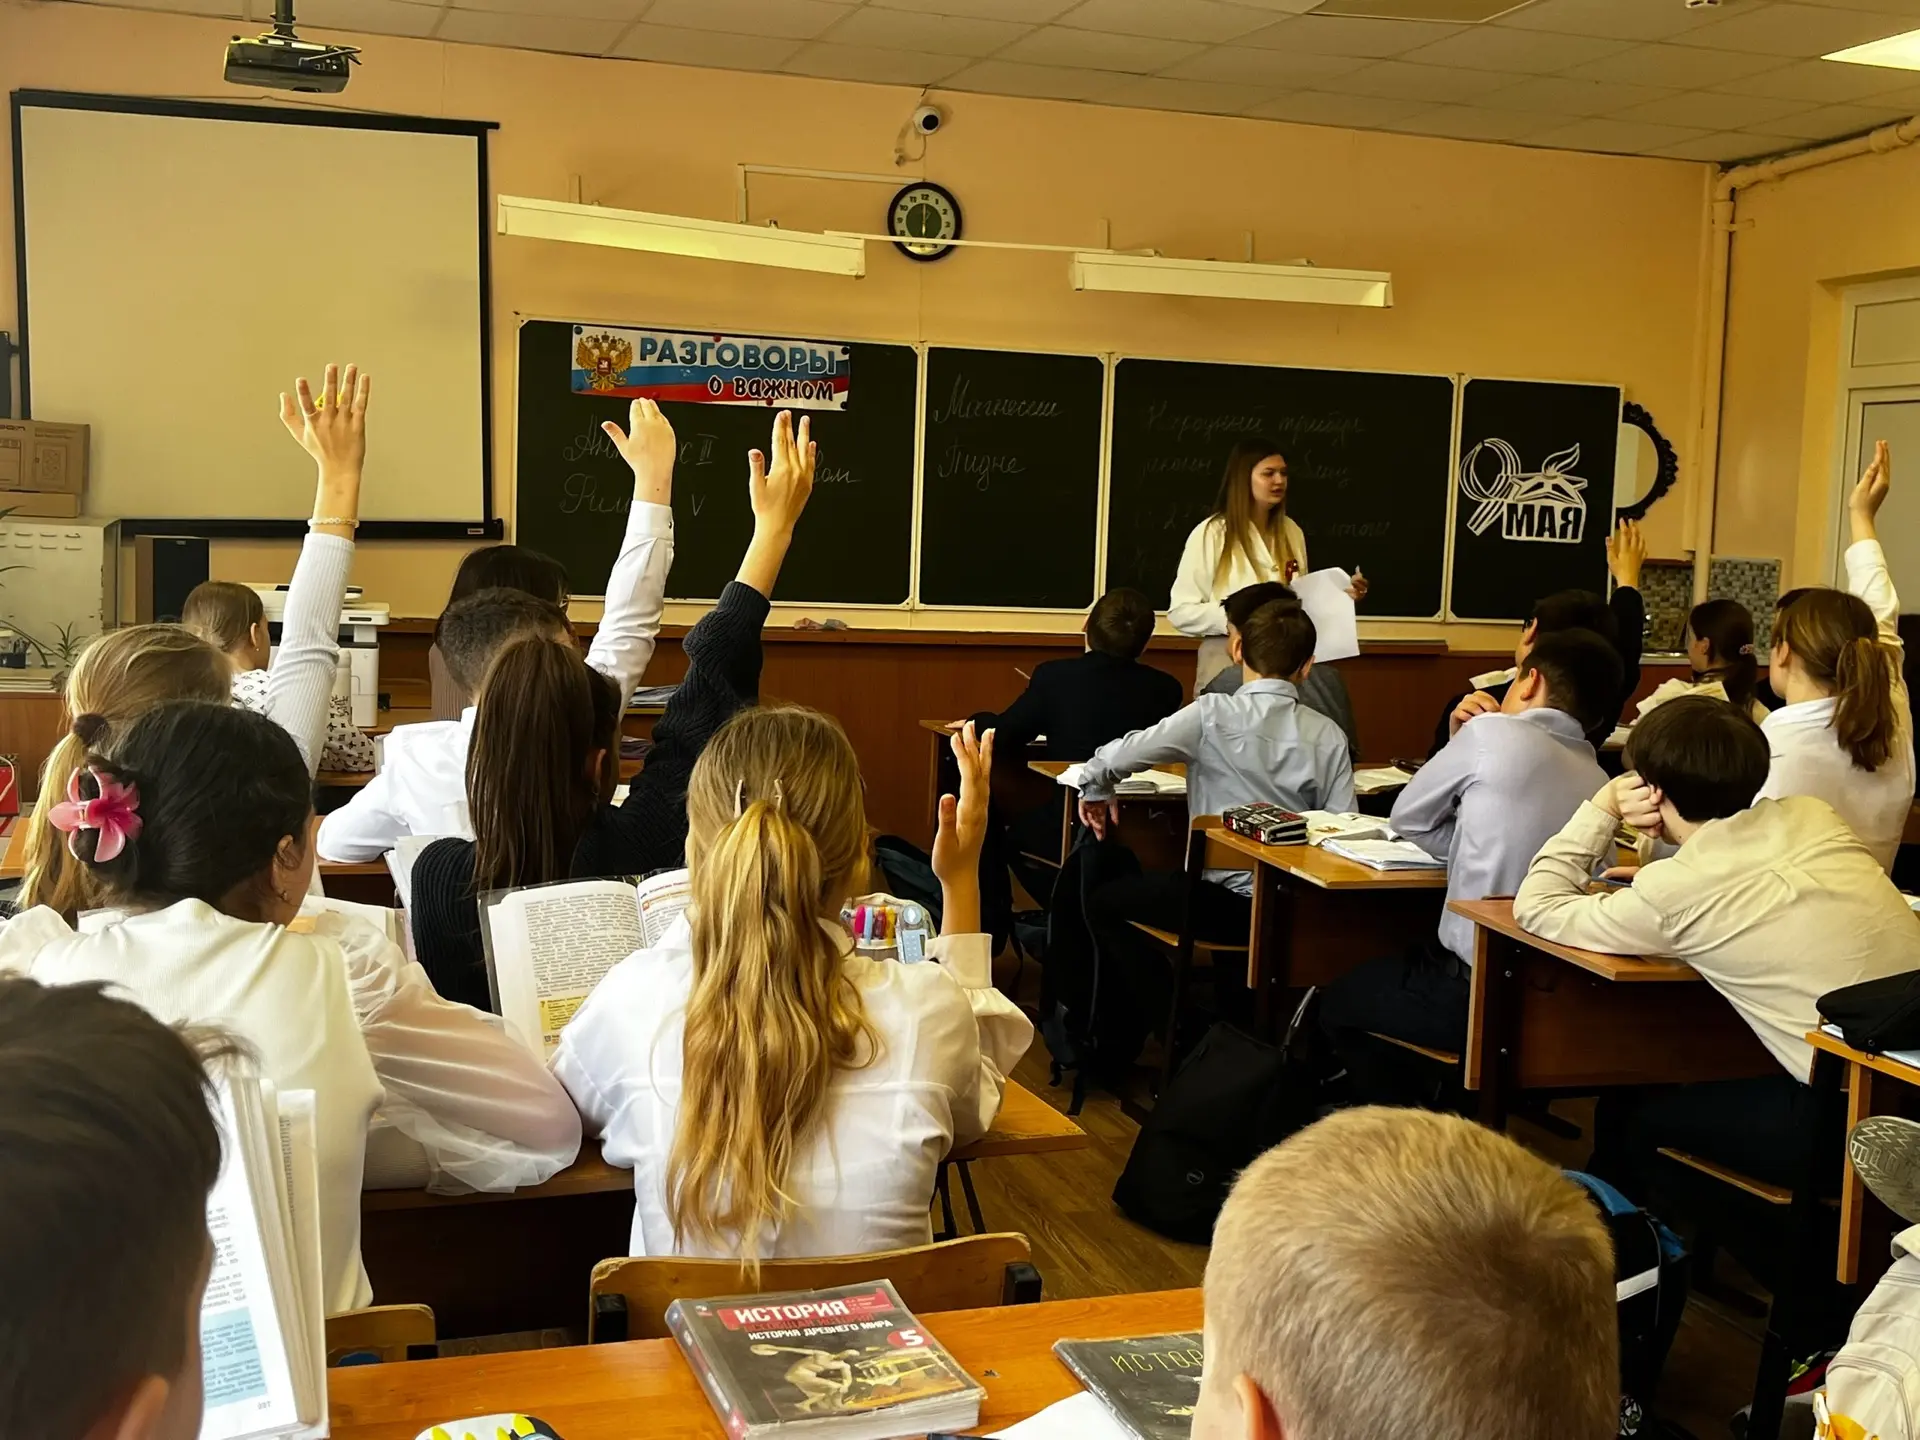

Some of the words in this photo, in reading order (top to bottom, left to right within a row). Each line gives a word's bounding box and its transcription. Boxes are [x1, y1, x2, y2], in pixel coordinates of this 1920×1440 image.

[639, 336, 837, 375] РАЗГОВОРЫ
[1505, 502, 1583, 540] МАЯ
[733, 1300, 851, 1325] ИСТОРИЯ
[748, 1328, 801, 1341] ИСТОРИЯ
[804, 1323, 860, 1337] ДРЕВНЕГО
[861, 1319, 894, 1331] МИРА
[899, 1329, 924, 1347] 5
[1110, 1348, 1204, 1373] ИСТОР
